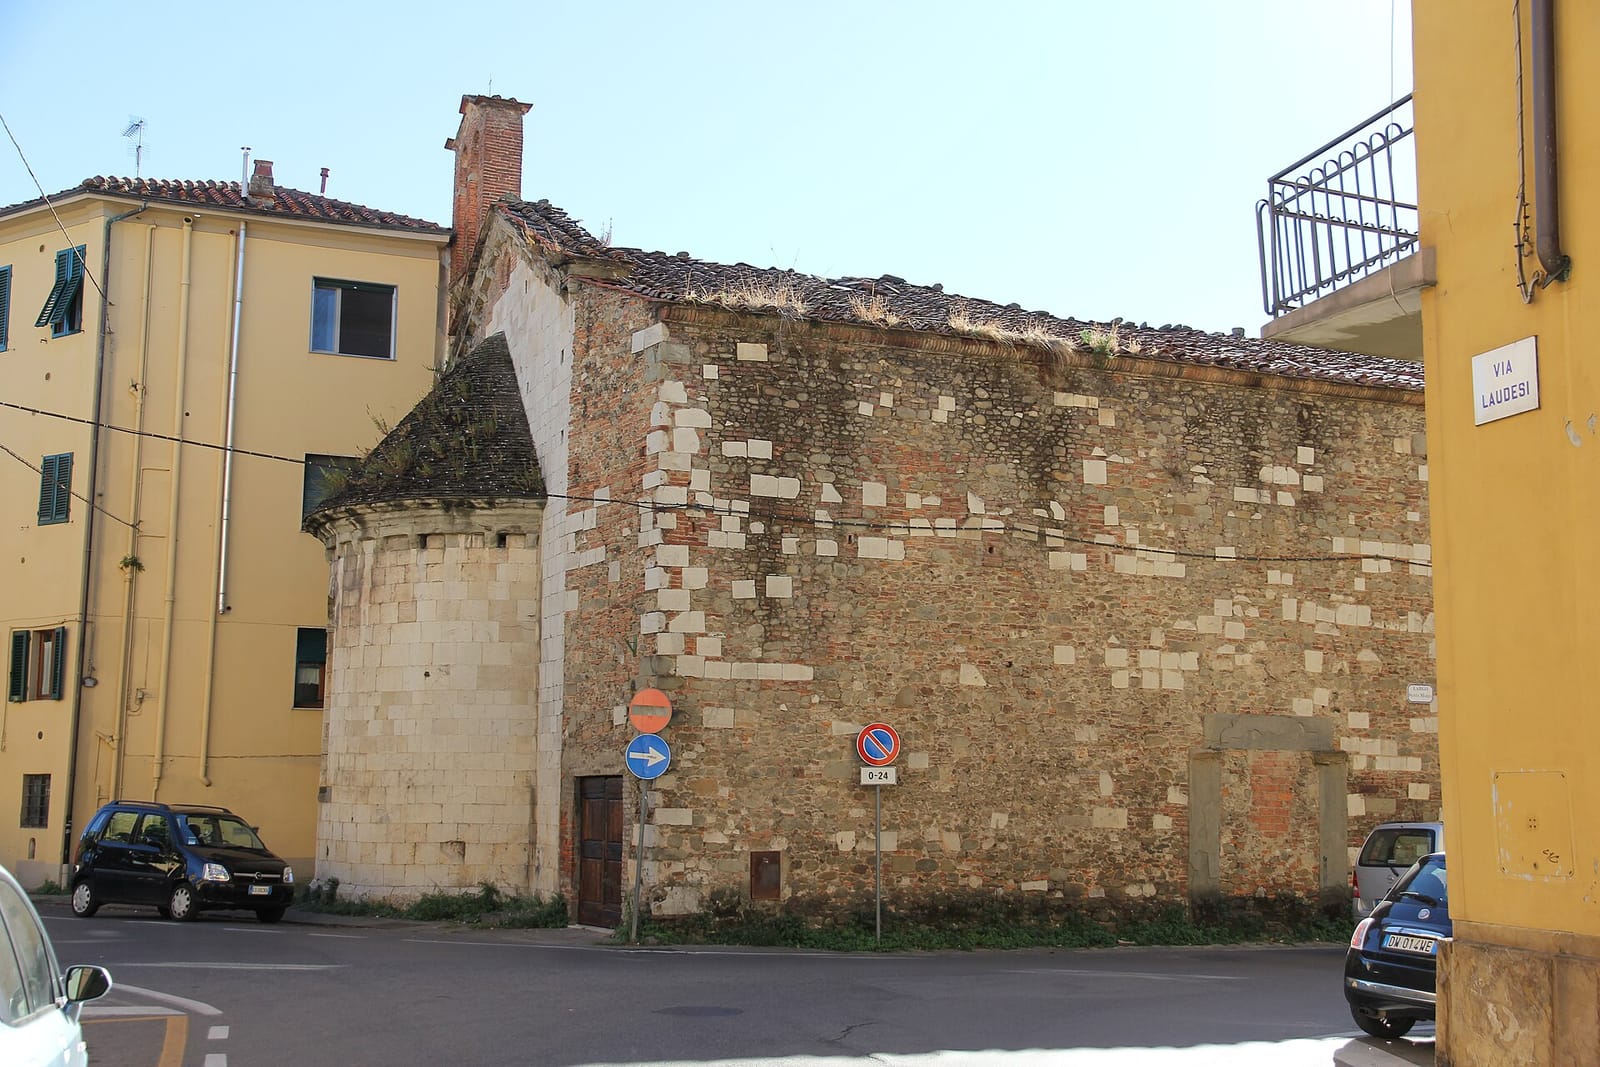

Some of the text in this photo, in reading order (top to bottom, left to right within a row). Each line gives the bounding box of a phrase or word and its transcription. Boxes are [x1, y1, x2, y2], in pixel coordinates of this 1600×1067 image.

[1493, 360, 1513, 377] VIA
[1482, 381, 1530, 408] LAUDESI
[868, 771, 889, 780] 0-24
